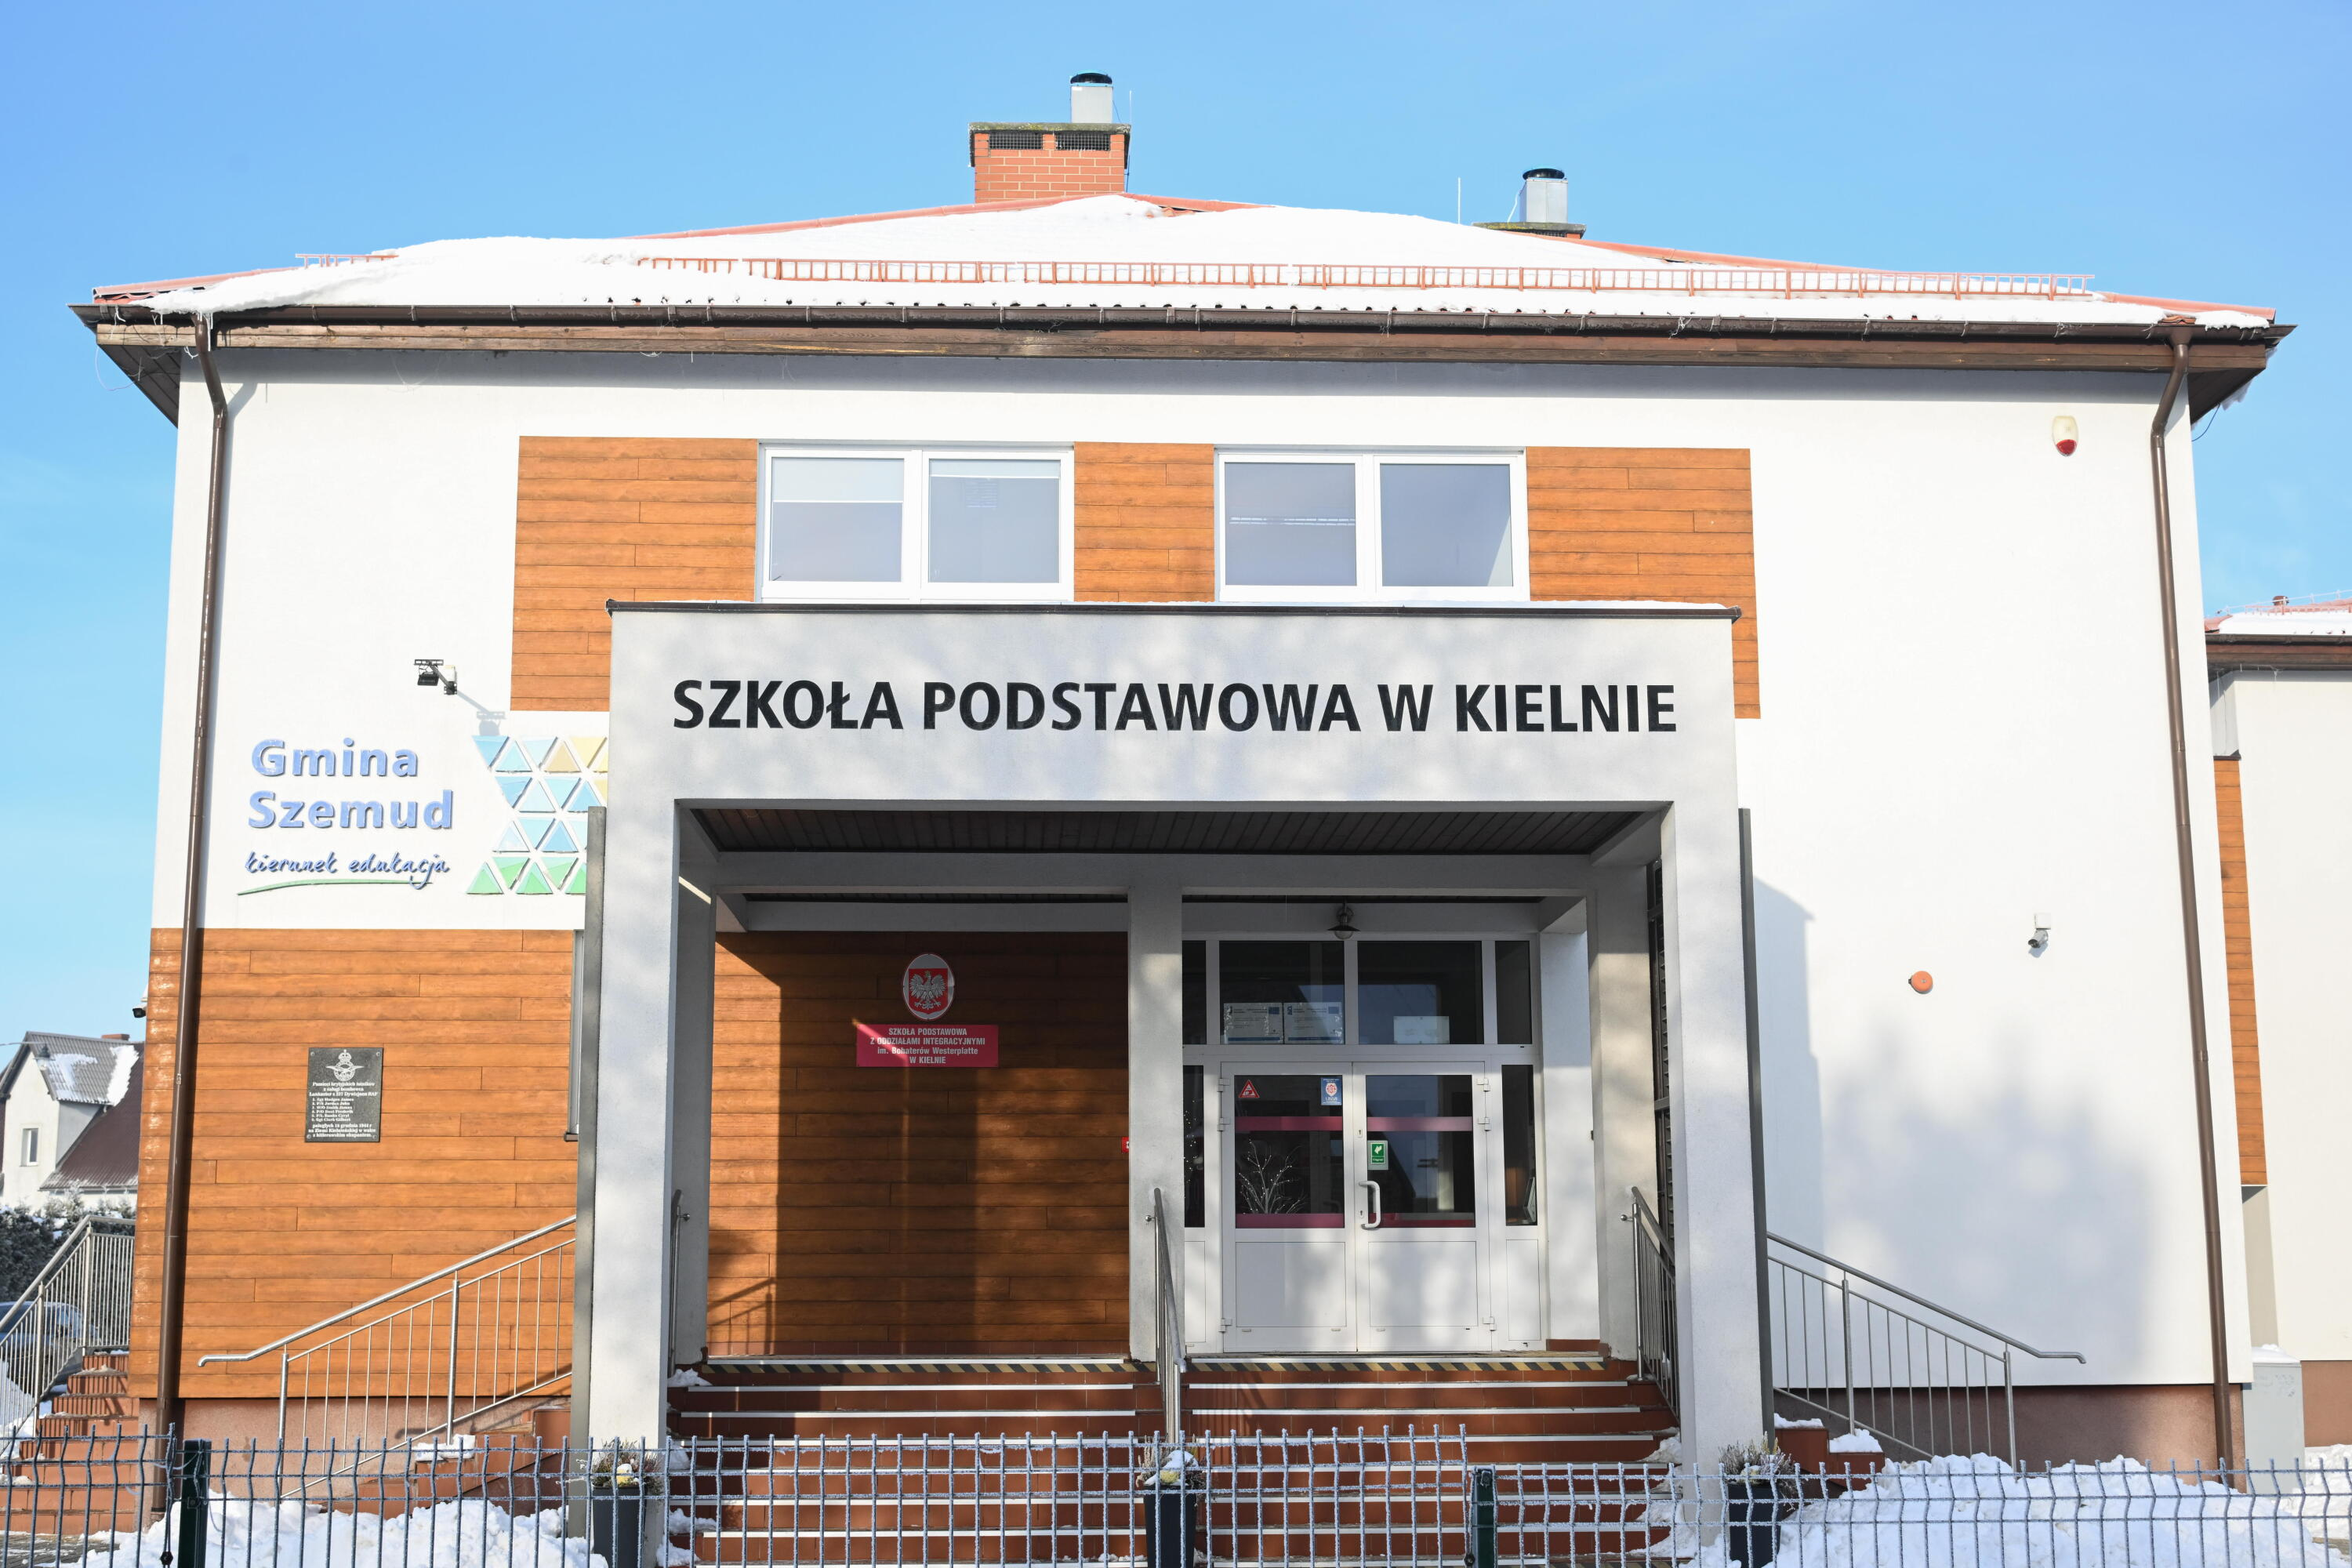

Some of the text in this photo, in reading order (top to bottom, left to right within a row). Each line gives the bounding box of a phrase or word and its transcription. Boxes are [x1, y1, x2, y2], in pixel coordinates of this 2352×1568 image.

[673, 680, 1676, 732] SZKOŁA PODSTAWOWA W KIELNIE
[252, 737, 418, 777] Gmina
[248, 789, 453, 829] Szemud
[245, 851, 450, 890] kierunek edukacja
[932, 1047, 978, 1056] Westerplatte
